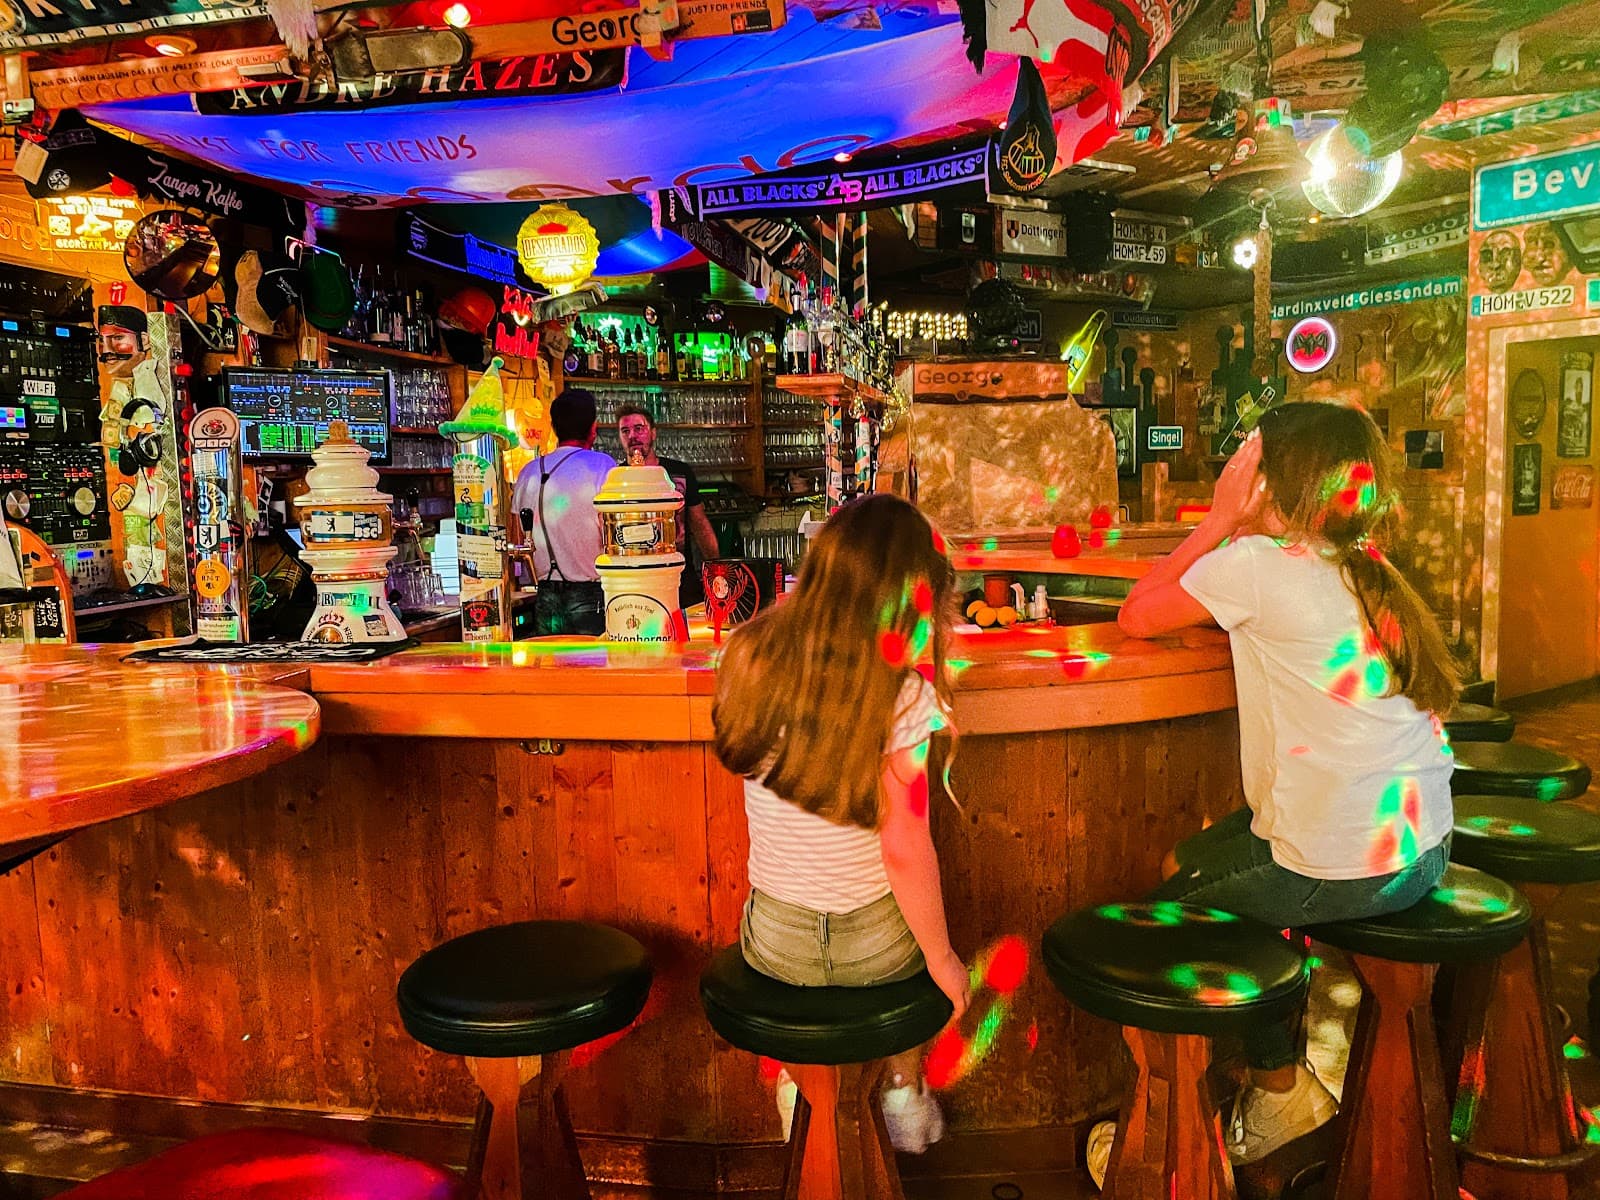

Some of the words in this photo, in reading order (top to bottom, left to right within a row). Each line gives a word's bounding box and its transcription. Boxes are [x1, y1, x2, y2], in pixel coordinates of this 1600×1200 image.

[687, 5, 708, 16] JUST
[711, 3, 729, 12] FOR
[419, 51, 594, 94] HAZES
[258, 137, 334, 164] FOR
[345, 133, 478, 164] FRIENDS
[706, 189, 739, 206] ALL
[864, 175, 899, 193] ALL
[1513, 159, 1600, 201] Bev
[55, 238, 87, 249] GEORG
[88, 240, 101, 250] AM
[523, 234, 587, 258] DESPERADOS
[1115, 243, 1133, 258] HOM
[1152, 249, 1165, 262] 59
[1482, 293, 1514, 312] HOM
[1524, 291, 1535, 309] V
[1539, 287, 1572, 306] 522
[1151, 431, 1180, 447] Singel
